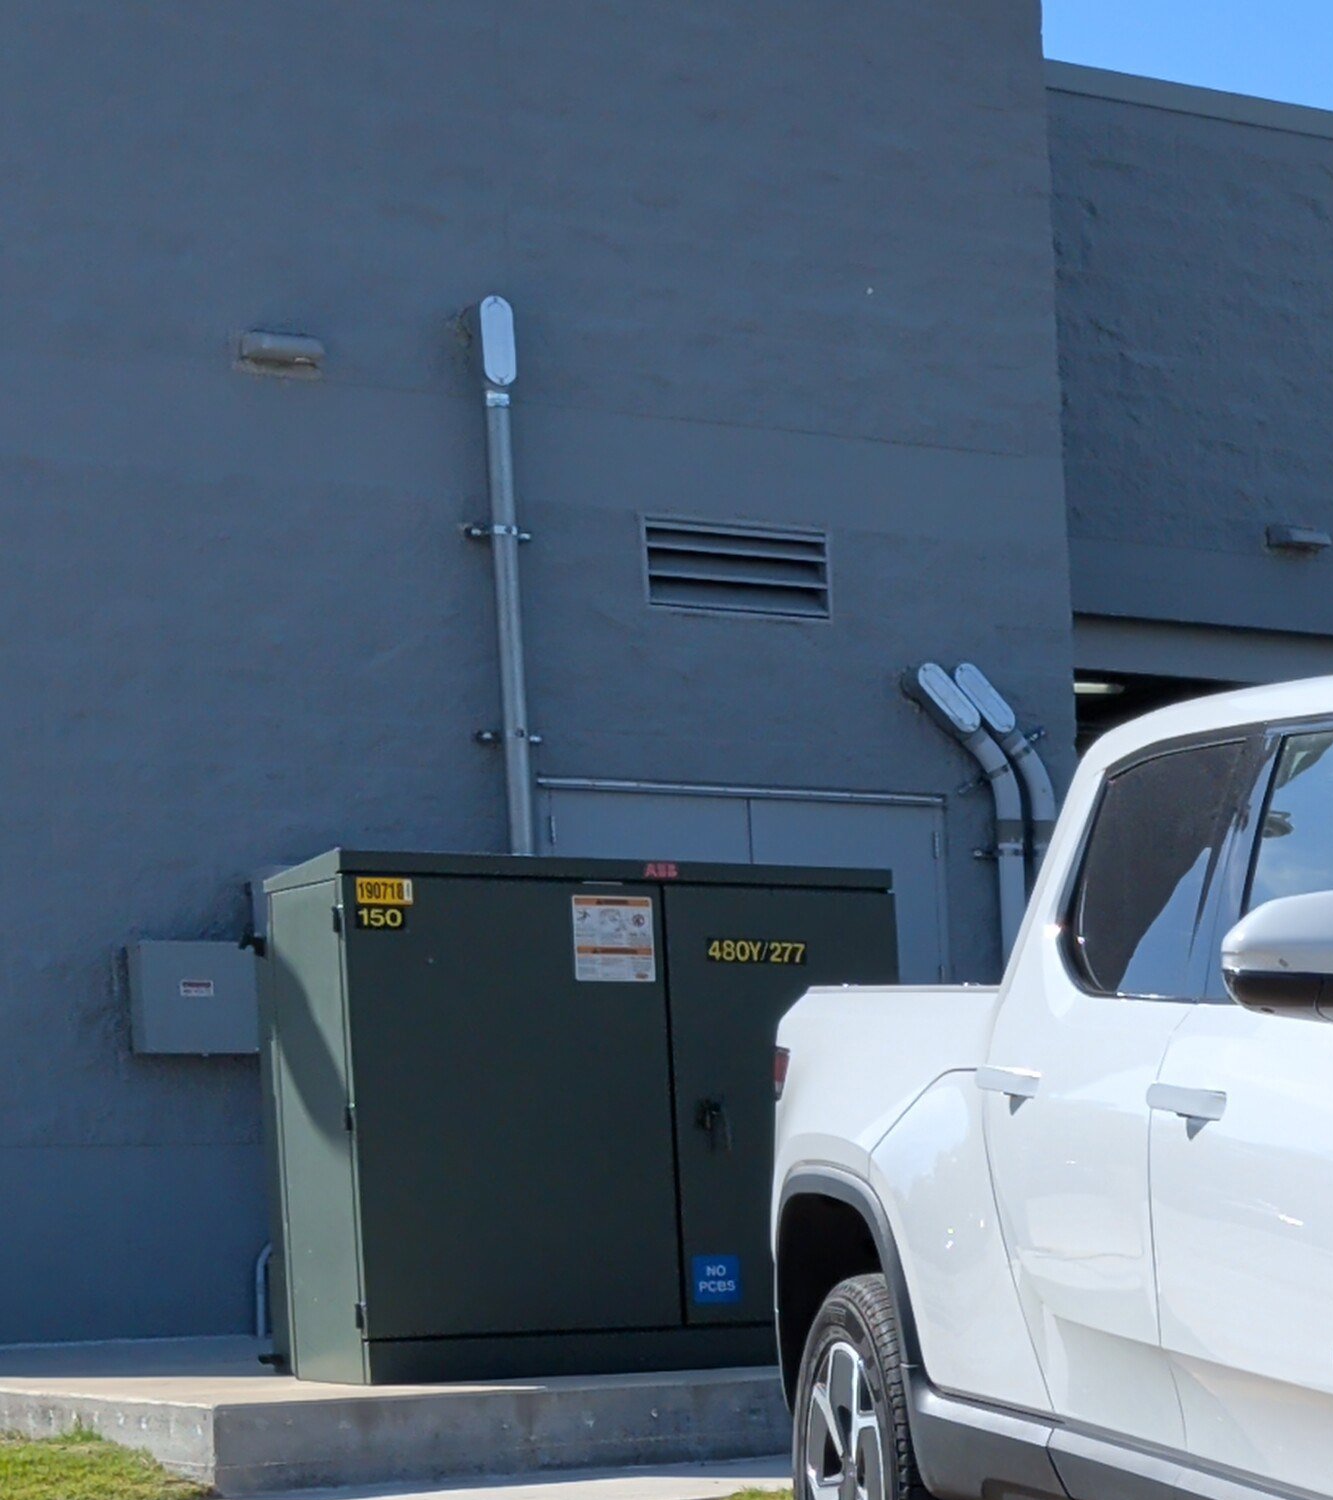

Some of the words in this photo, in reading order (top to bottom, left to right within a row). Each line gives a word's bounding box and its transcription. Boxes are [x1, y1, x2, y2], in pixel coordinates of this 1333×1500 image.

[357, 907, 403, 927] 150
[708, 940, 806, 963] 480Y/277
[706, 1264, 727, 1277] NO
